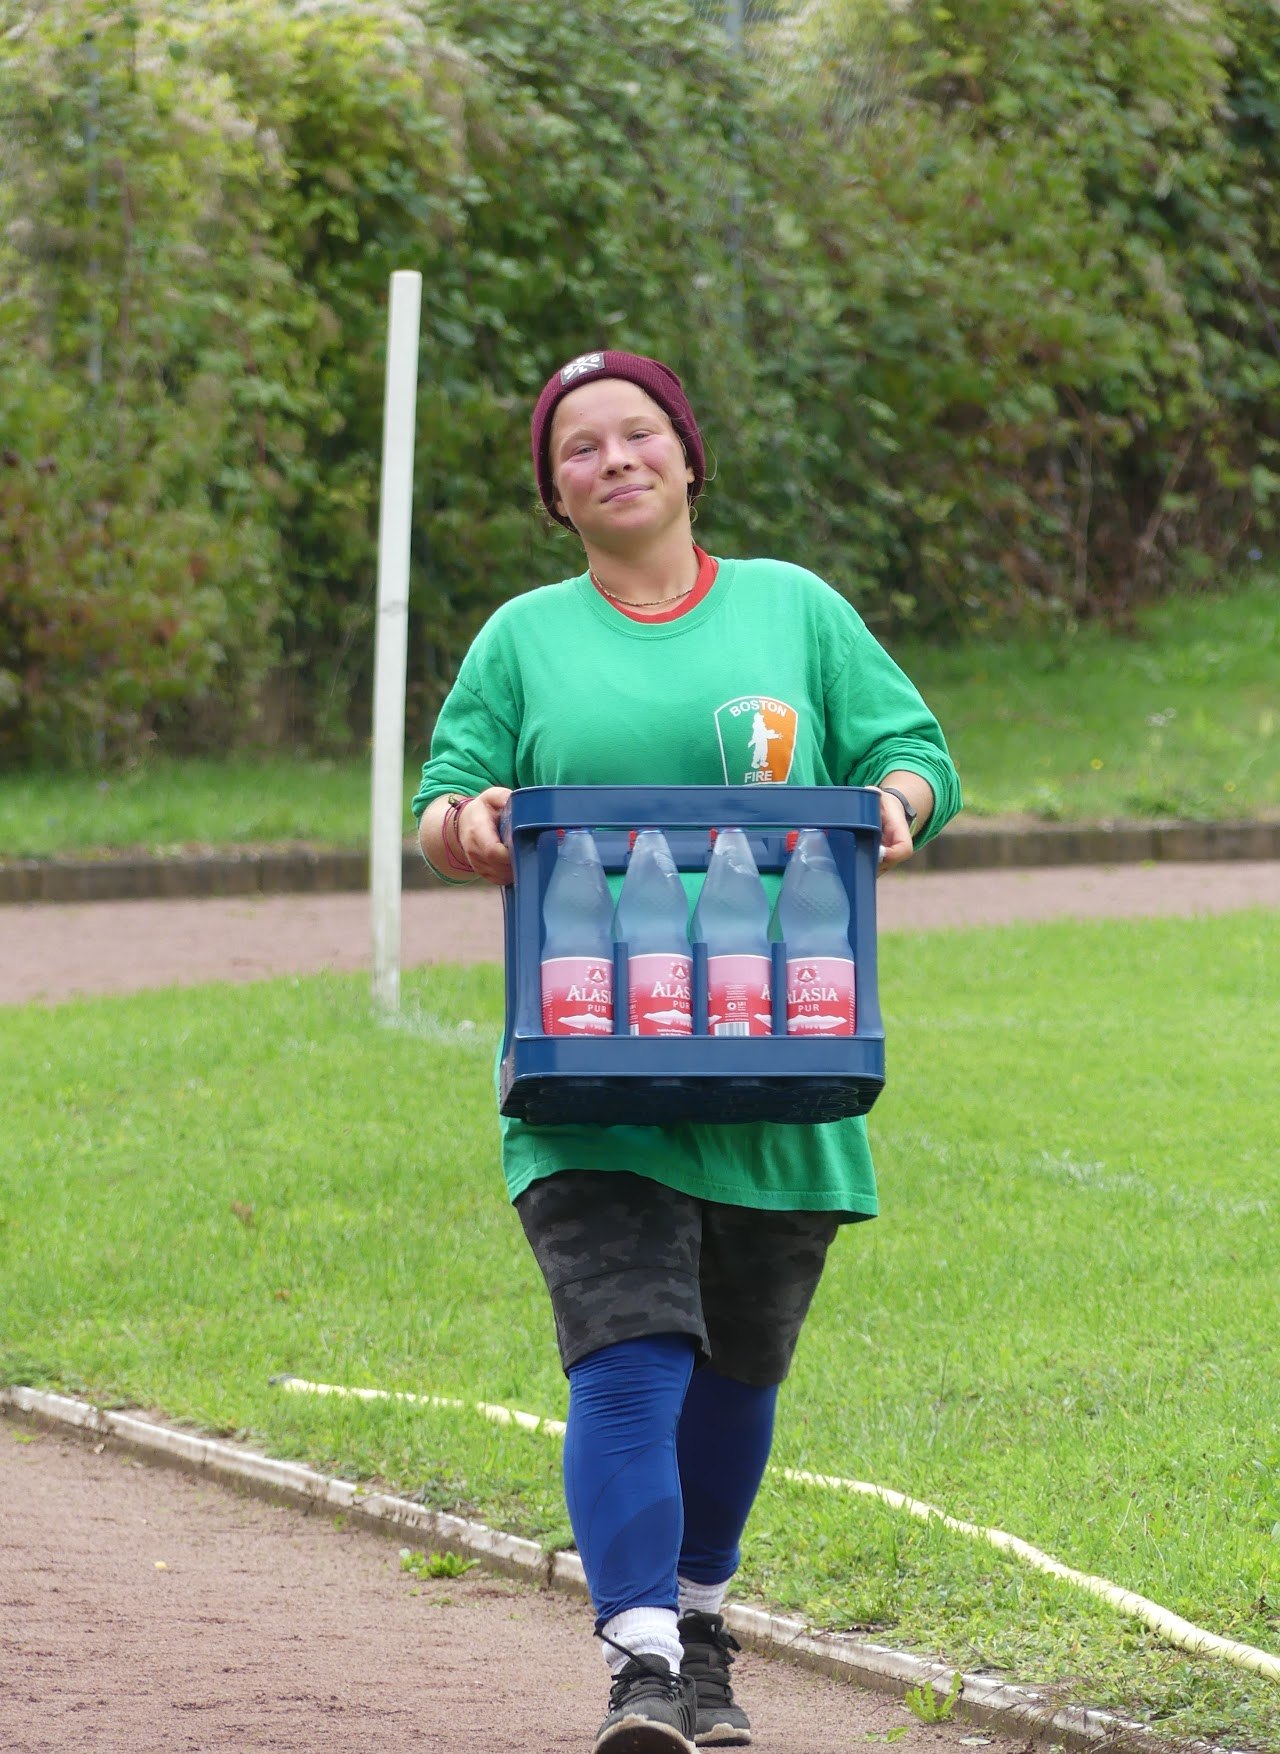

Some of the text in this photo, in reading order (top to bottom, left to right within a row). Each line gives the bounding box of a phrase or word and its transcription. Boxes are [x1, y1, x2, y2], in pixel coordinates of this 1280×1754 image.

[729, 699, 787, 717] BOSTON
[744, 770, 773, 783] FIRE
[566, 985, 613, 1005] ALASI
[650, 981, 690, 1000] ALAS
[587, 1004, 607, 1013] PUR
[673, 1000, 690, 1009] PUR
[798, 1004, 820, 1012] PUR
